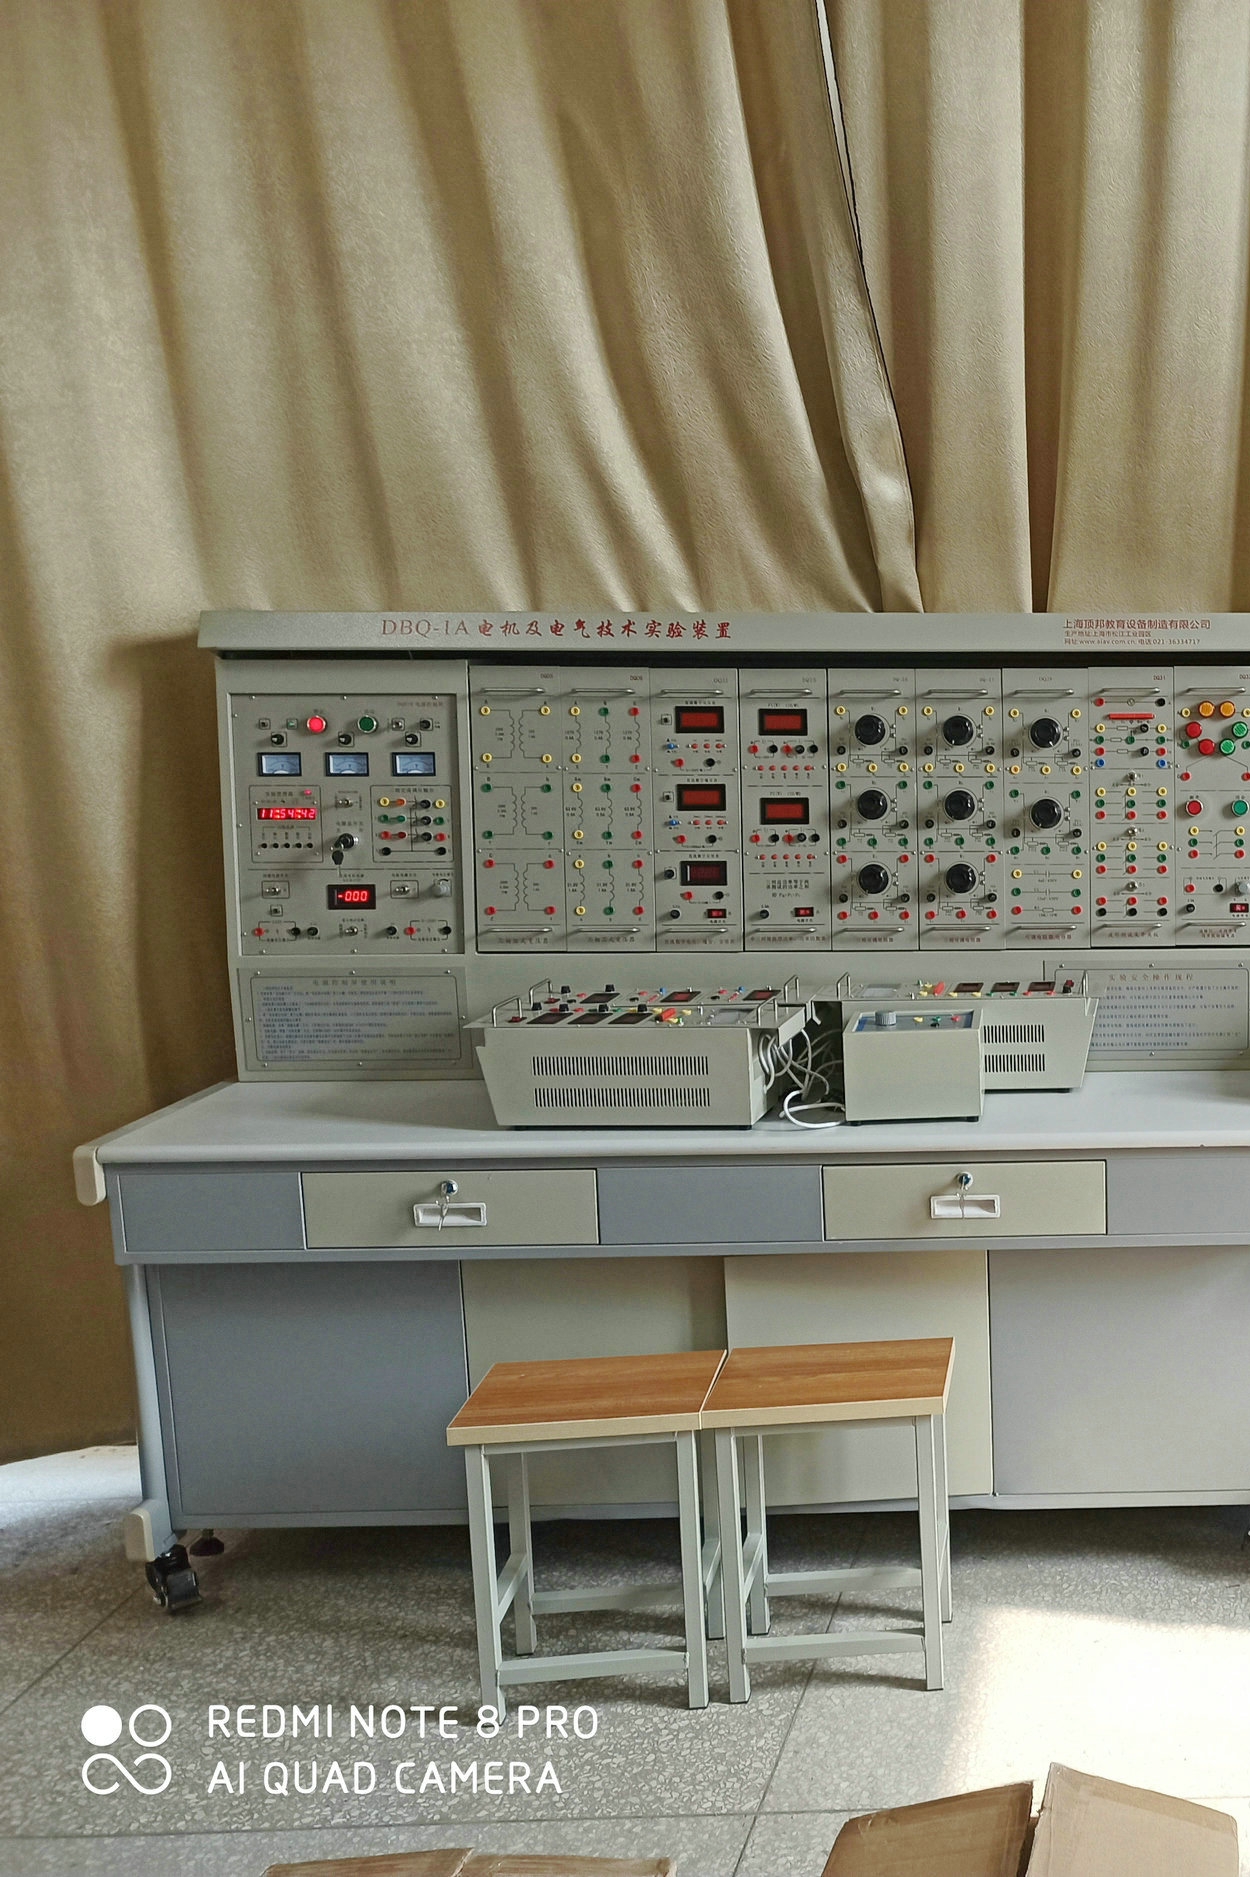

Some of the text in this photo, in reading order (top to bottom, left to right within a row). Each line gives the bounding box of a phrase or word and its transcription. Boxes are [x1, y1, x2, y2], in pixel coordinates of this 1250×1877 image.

[381, 618, 732, 639] DBQ-1A 电机及电气技术实验装置
[1063, 619, 1211, 629] 上海顶邦教育设备制造有限公司
